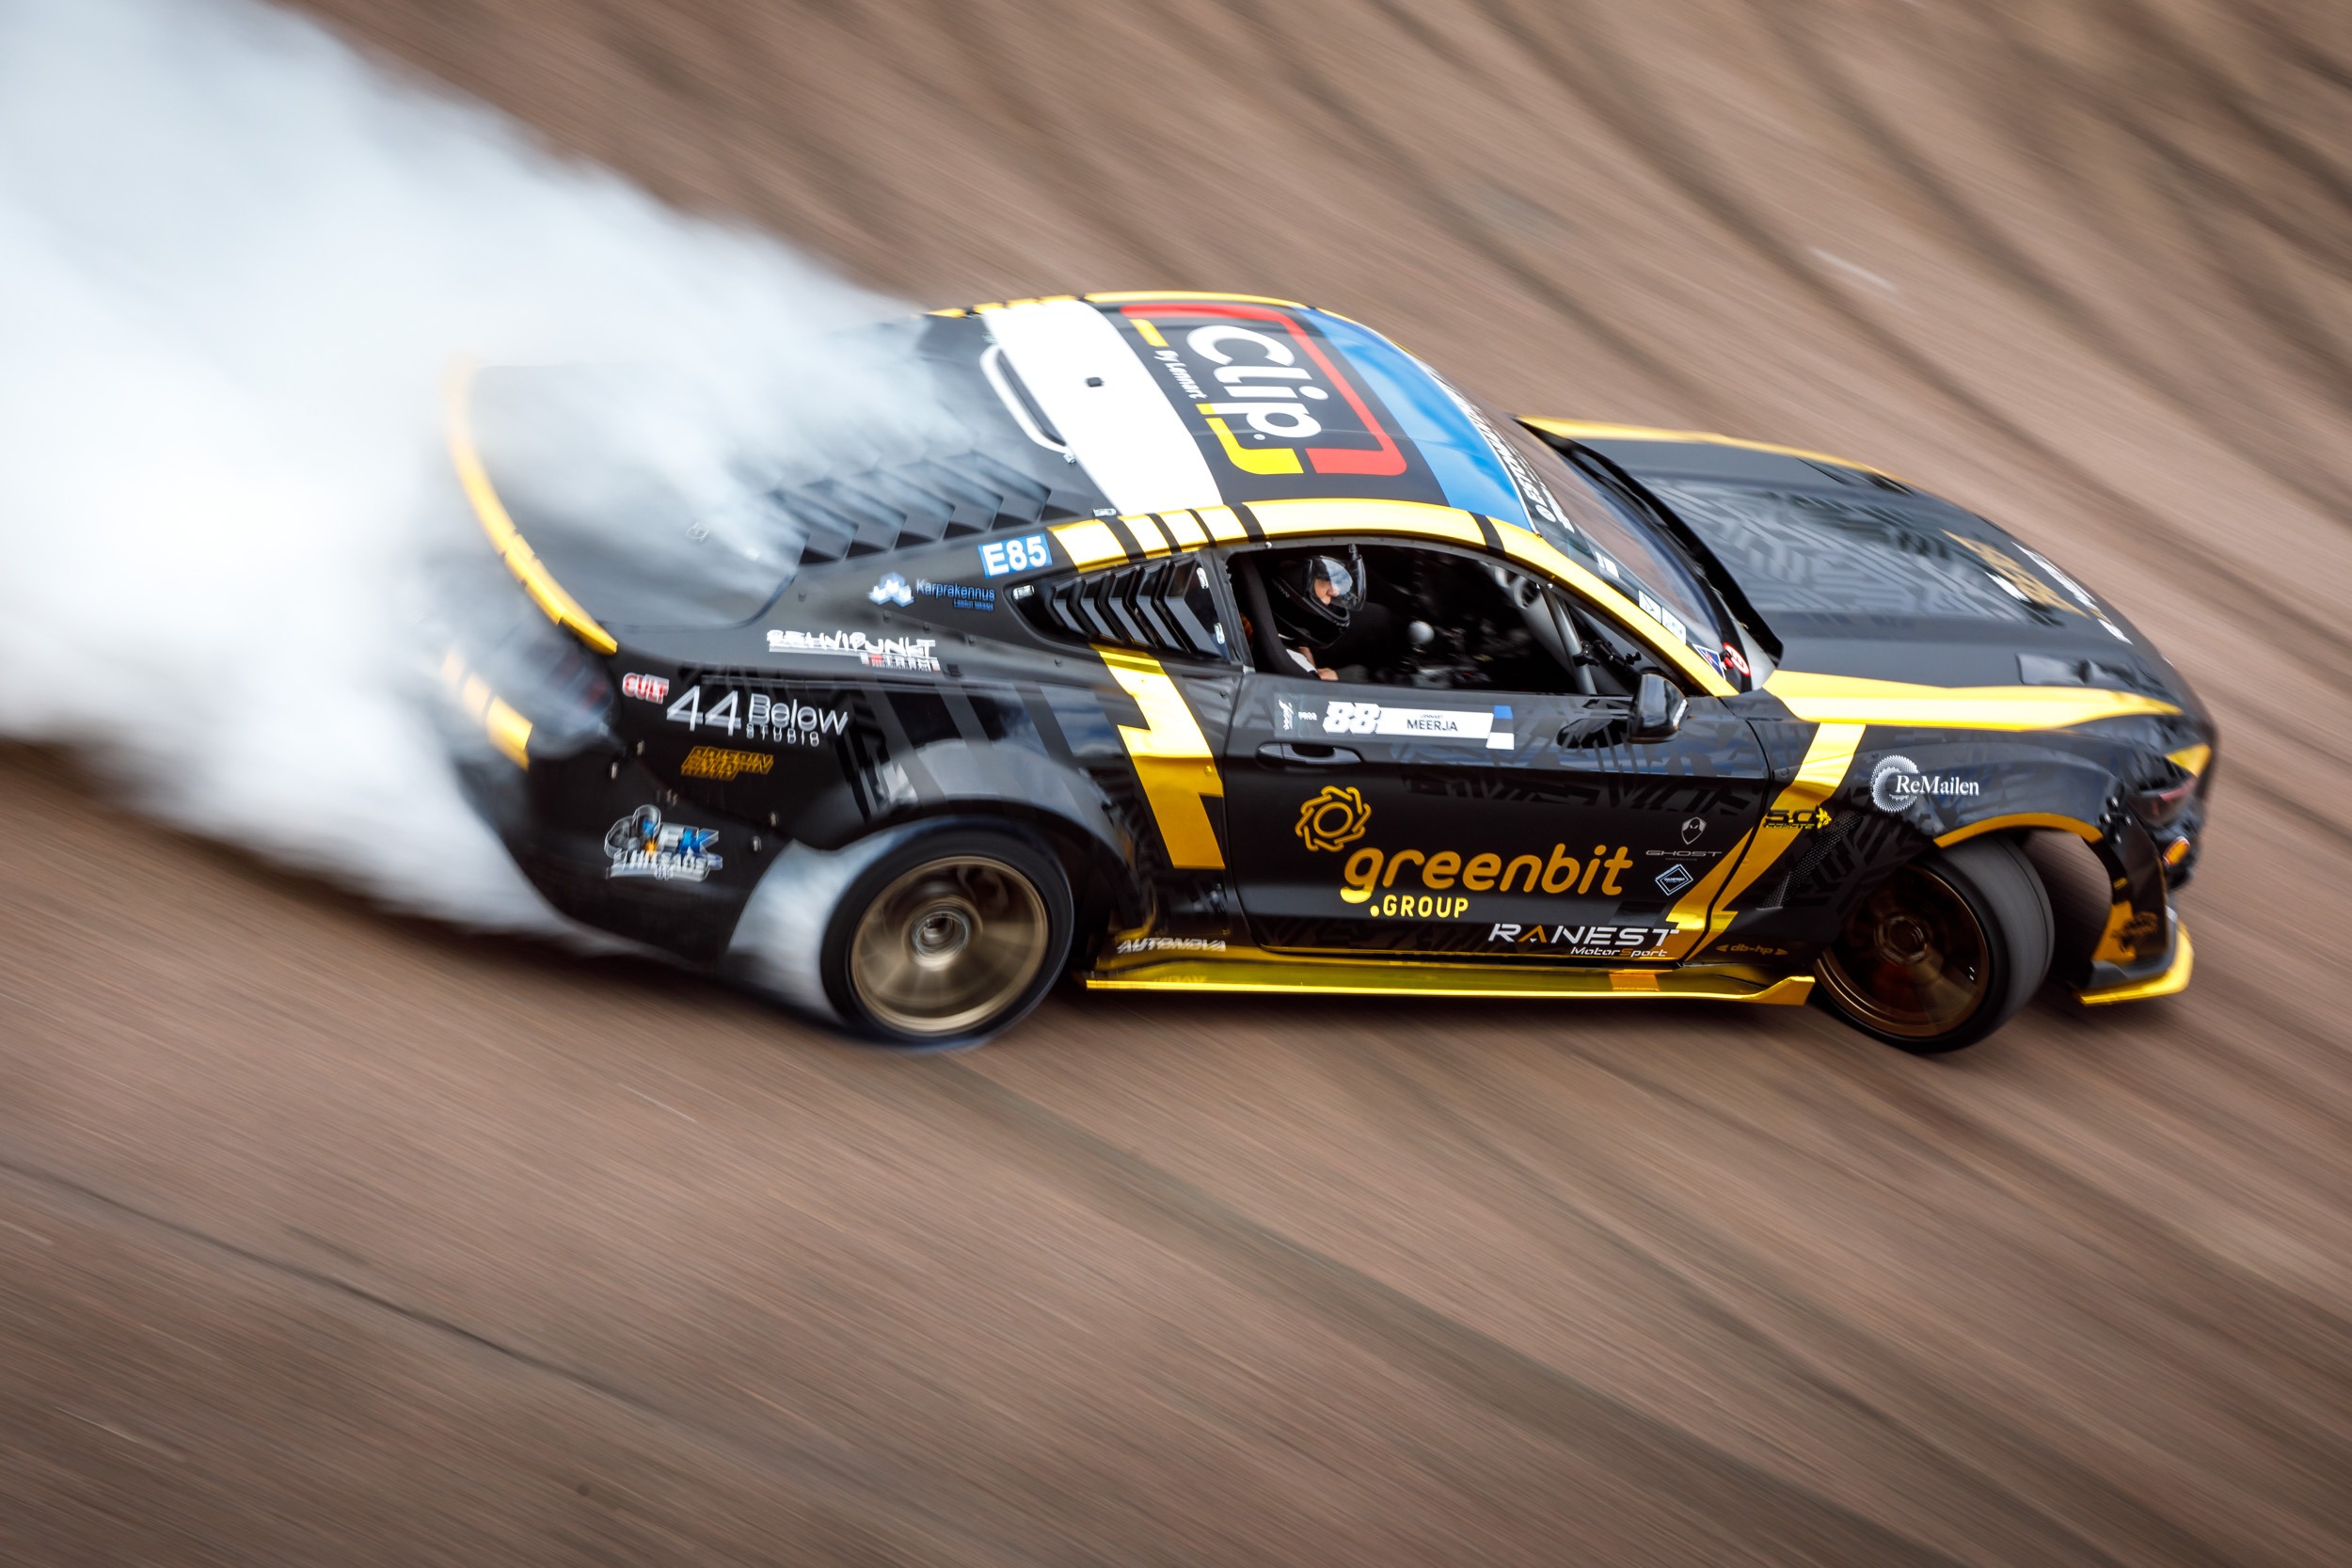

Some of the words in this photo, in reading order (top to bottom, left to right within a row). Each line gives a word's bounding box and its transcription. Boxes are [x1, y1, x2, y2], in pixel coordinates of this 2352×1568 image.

[1186, 325, 1329, 438] Clip
[982, 535, 1048, 577] E85
[915, 578, 995, 602] Karprakennus
[621, 672, 670, 705] CULT
[666, 685, 742, 736] 44
[748, 692, 849, 736] Below
[1322, 701, 1382, 736] 88
[1406, 718, 1458, 732] MEERJA
[1895, 774, 1979, 797] ReMailen
[1765, 808, 1817, 824] 5.0
[1645, 849, 1723, 858] GHOST
[1340, 843, 1633, 904] greenbit
[1370, 894, 1470, 919] .GROUP
[1117, 937, 1227, 953] AUTONOVA
[1487, 923, 1680, 947] RANEST
[1570, 945, 1669, 958] MotorSport
[1730, 943, 1774, 956] db-hp
